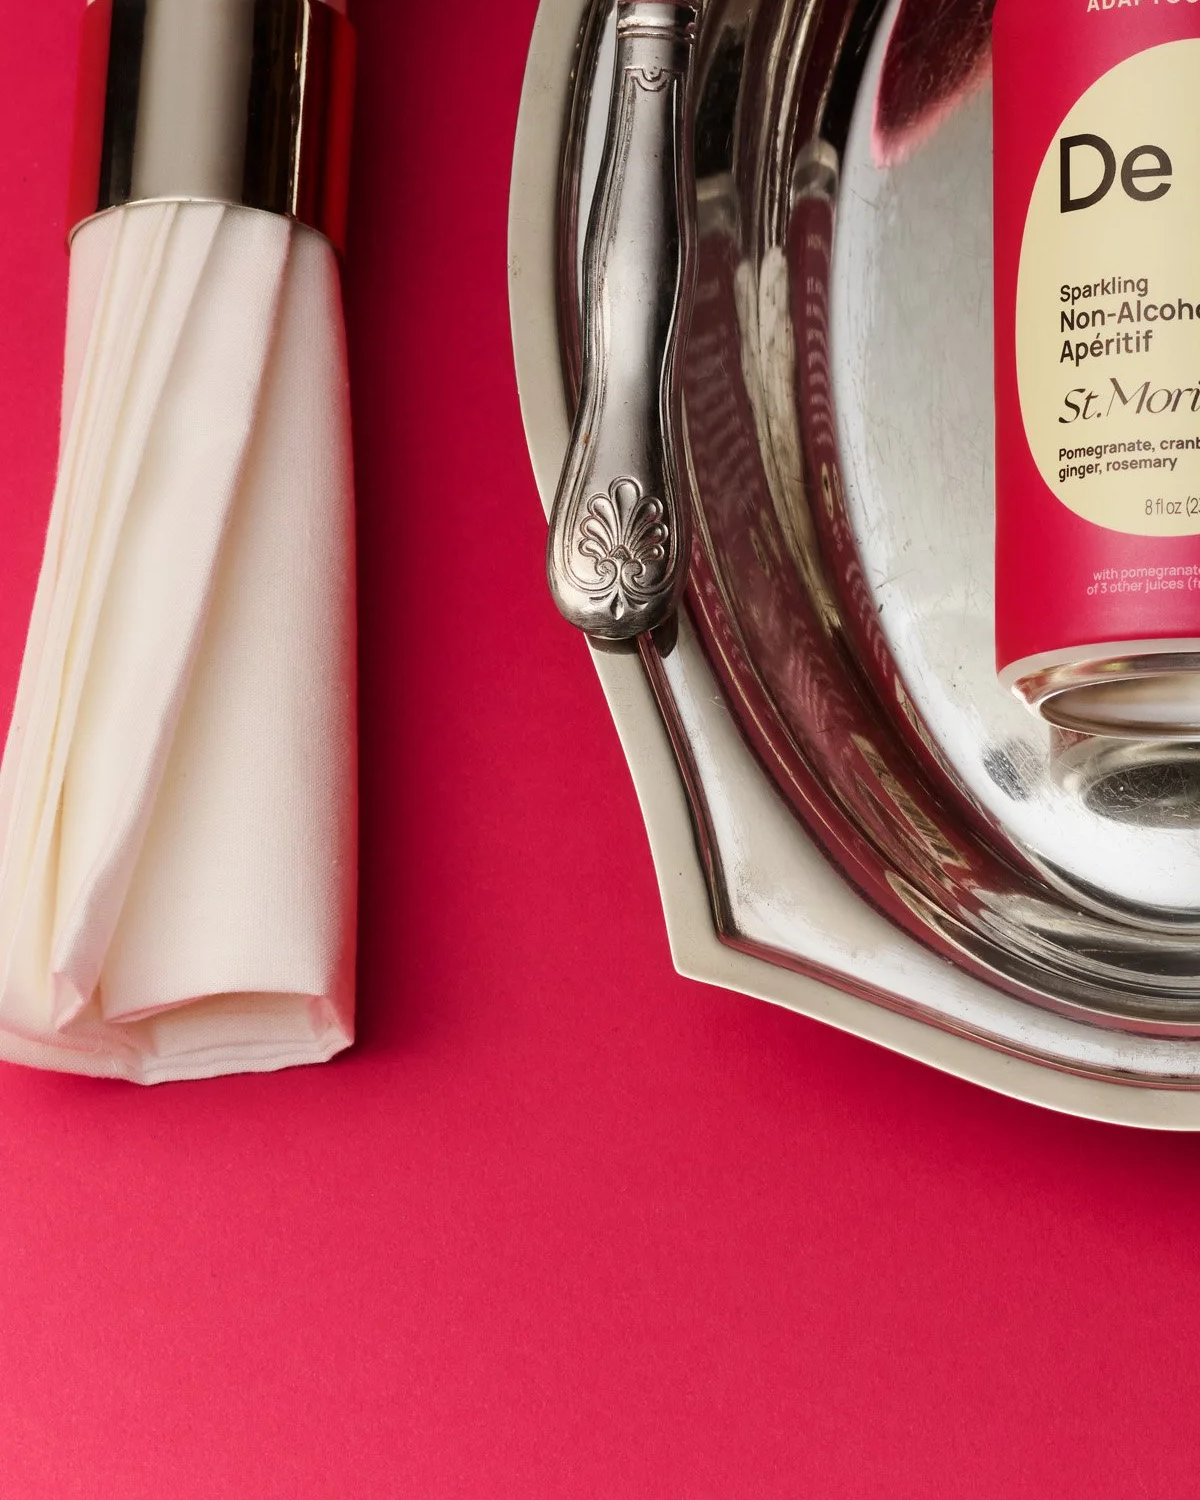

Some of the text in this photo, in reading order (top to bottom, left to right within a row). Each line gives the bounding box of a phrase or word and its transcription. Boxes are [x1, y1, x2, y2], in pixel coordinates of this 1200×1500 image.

[1060, 133, 1173, 214] De
[1060, 276, 1148, 305] Sparkling
[1060, 329, 1153, 367] Apéritif
[1058, 387, 1102, 424] St.
[1058, 439, 1155, 461] Pomegranate,
[1058, 456, 1178, 483] ginger, rosemary
[1144, 498, 1153, 515] 8
[1166, 501, 1182, 514] oz
[1086, 583, 1098, 596] of
[1109, 579, 1143, 594] other
[1144, 578, 1184, 594] juices
[1092, 567, 1119, 581] with
